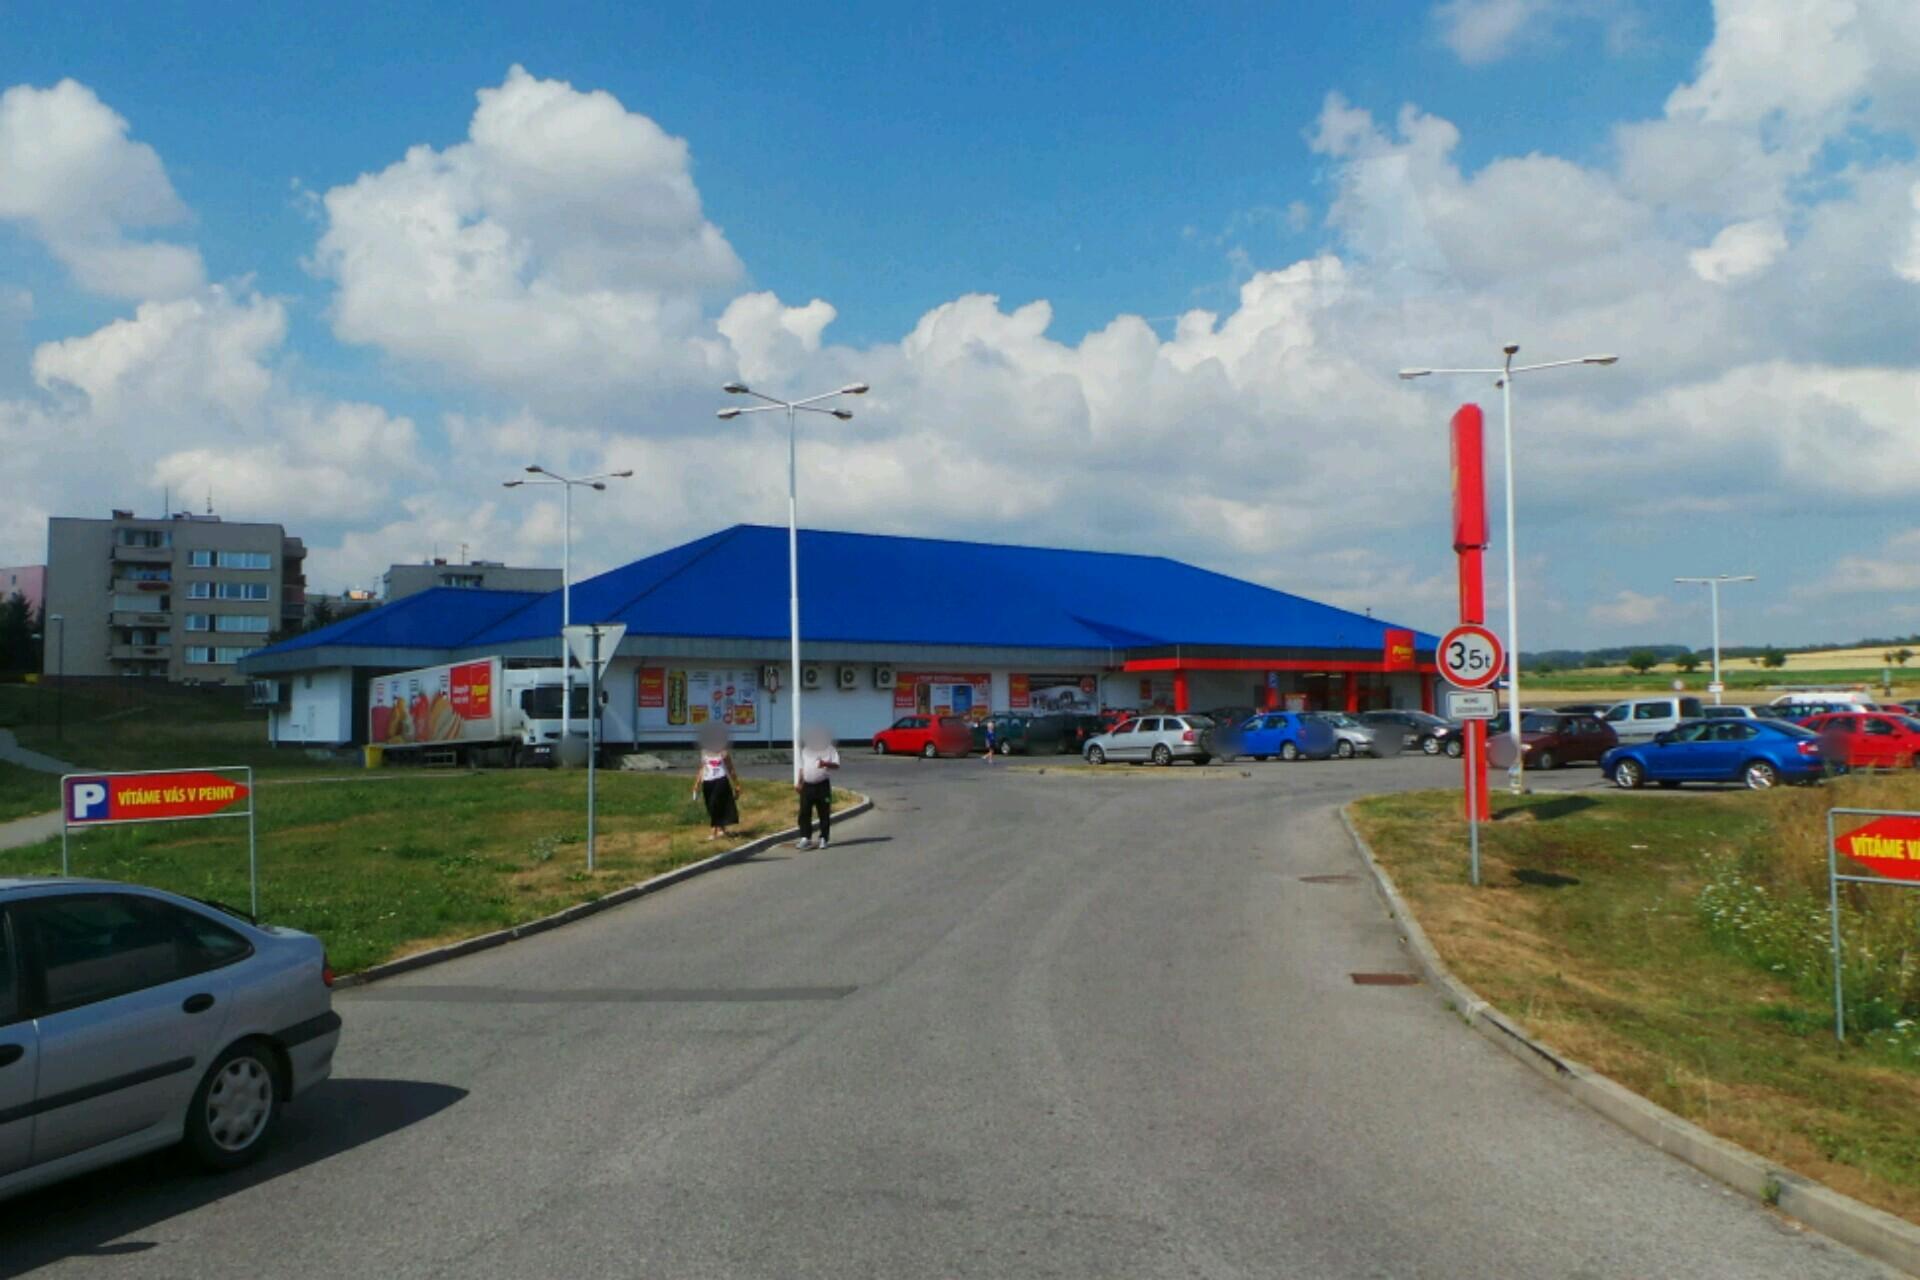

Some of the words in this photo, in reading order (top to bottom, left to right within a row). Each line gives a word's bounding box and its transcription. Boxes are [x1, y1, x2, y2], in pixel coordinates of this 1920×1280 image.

[73, 783, 106, 818] P
[117, 788, 161, 806] VÍTÁME
[163, 786, 186, 804] VÁS
[187, 788, 197, 802] V
[198, 785, 237, 801] PENNY
[1850, 832, 1906, 859] VÍTÁME
